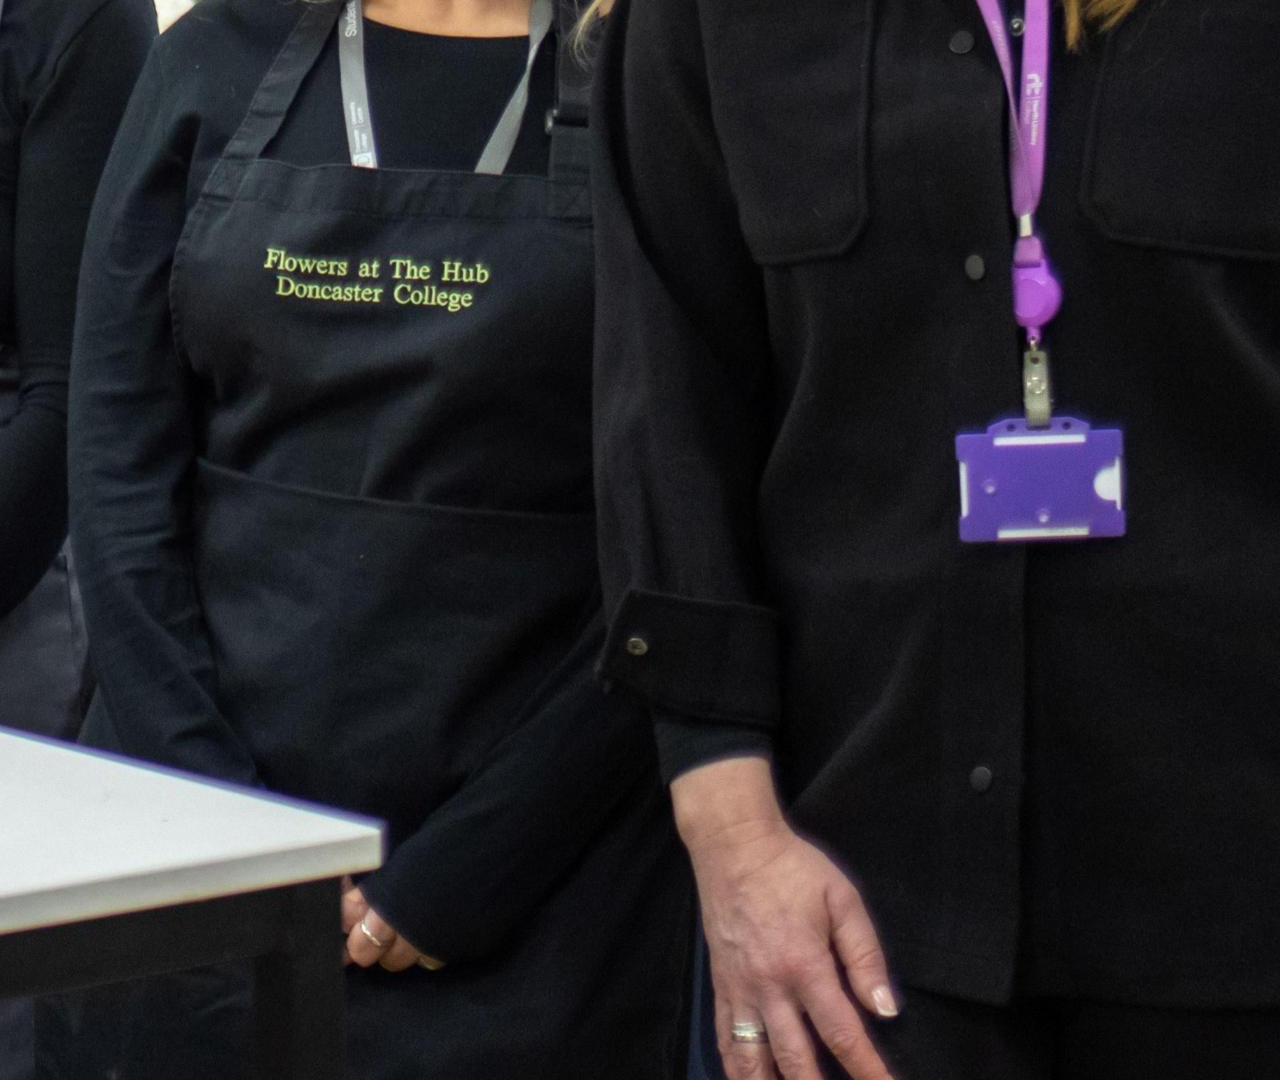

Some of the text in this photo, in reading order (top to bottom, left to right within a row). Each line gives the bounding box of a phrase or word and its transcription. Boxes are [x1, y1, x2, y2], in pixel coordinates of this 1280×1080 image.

[263, 248, 490, 284] Flowers at The Hub
[276, 275, 473, 313] Doncaster College
